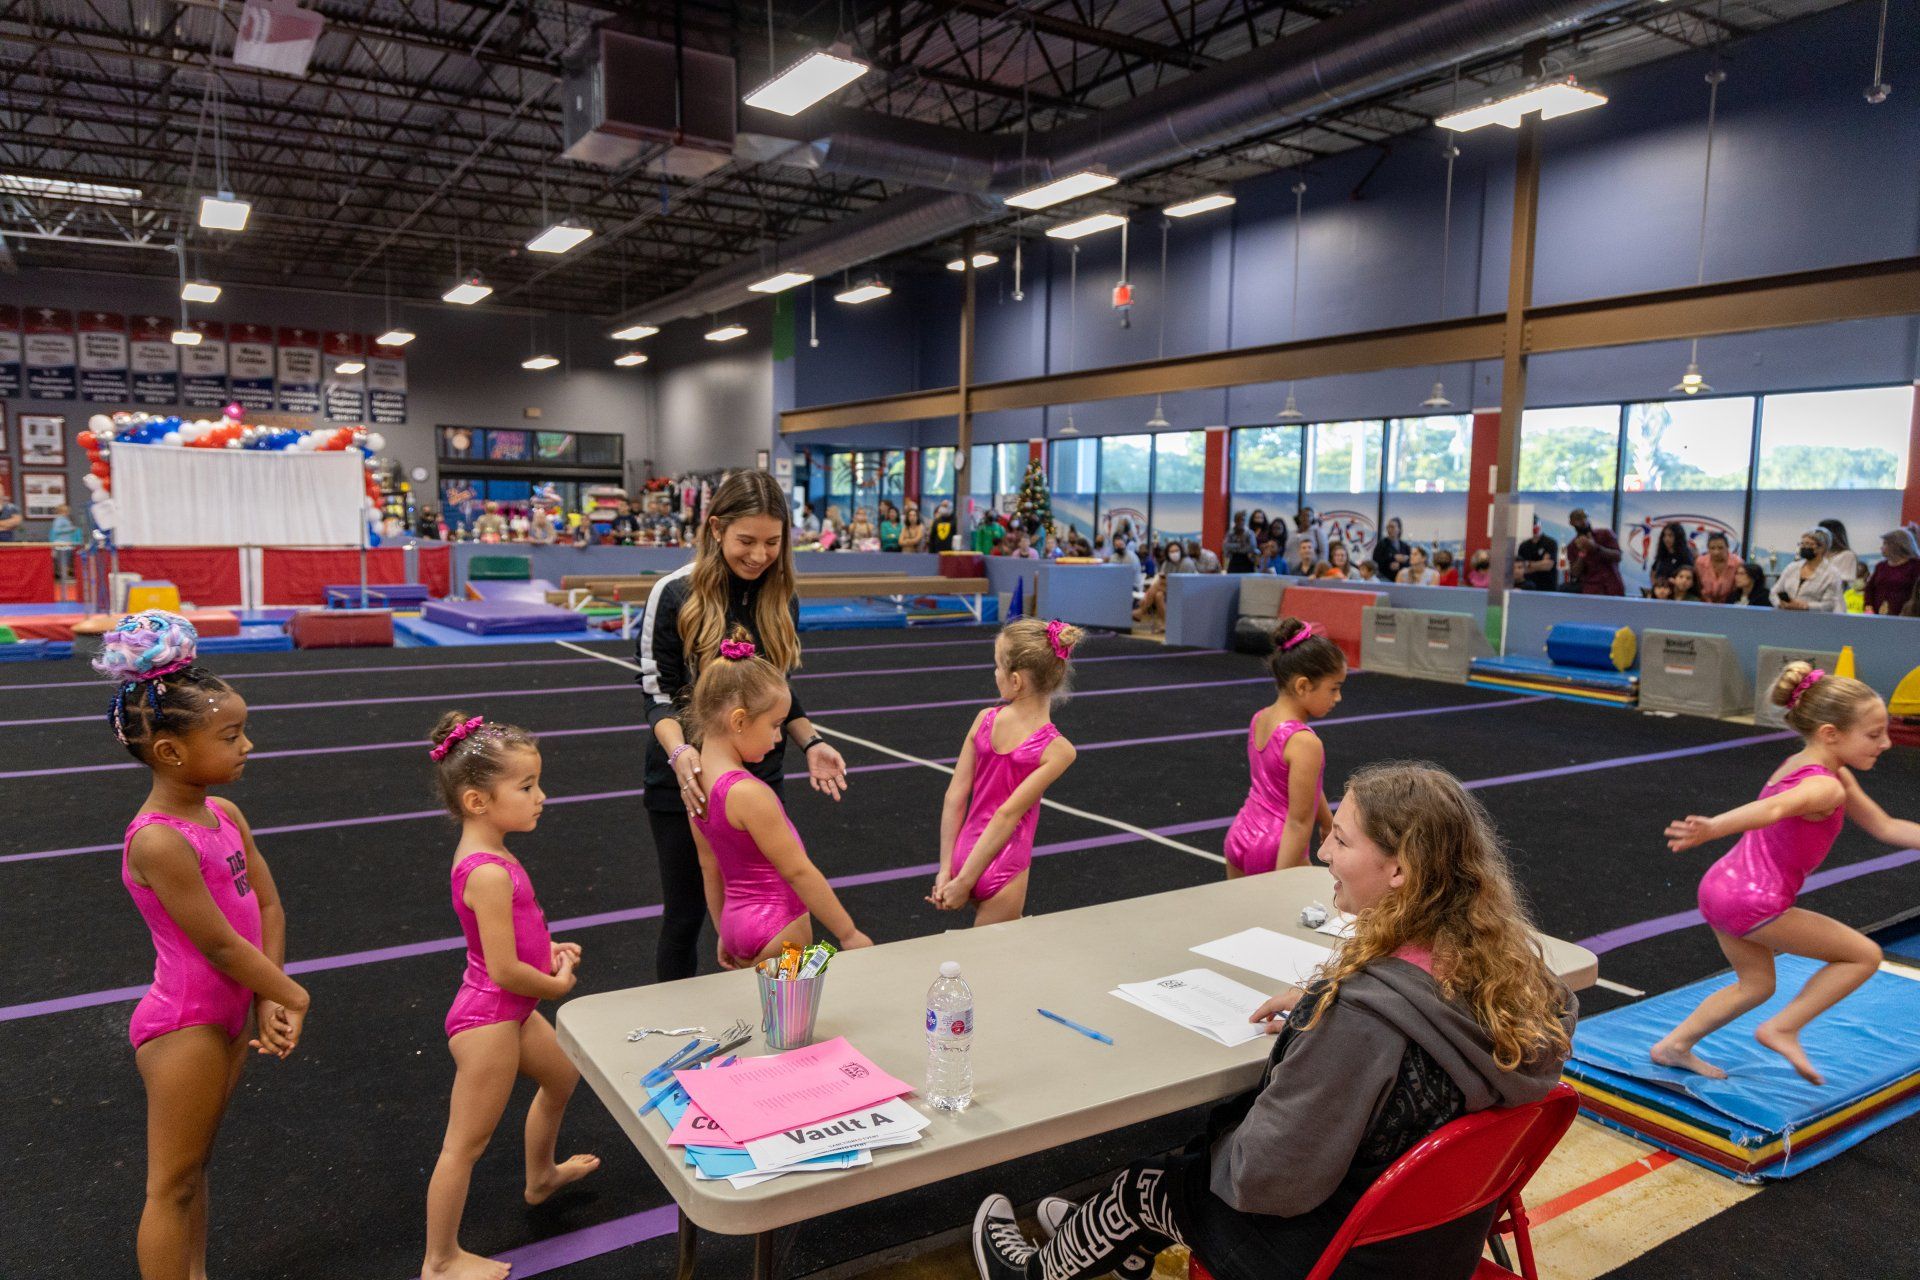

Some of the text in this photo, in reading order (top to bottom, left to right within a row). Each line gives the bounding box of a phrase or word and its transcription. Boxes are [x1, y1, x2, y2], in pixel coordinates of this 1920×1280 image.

[226, 850, 245, 876] TAG
[691, 1116, 724, 1131] Co
[784, 1112, 895, 1145] Vault A
[1039, 1168, 1140, 1280] PINK
